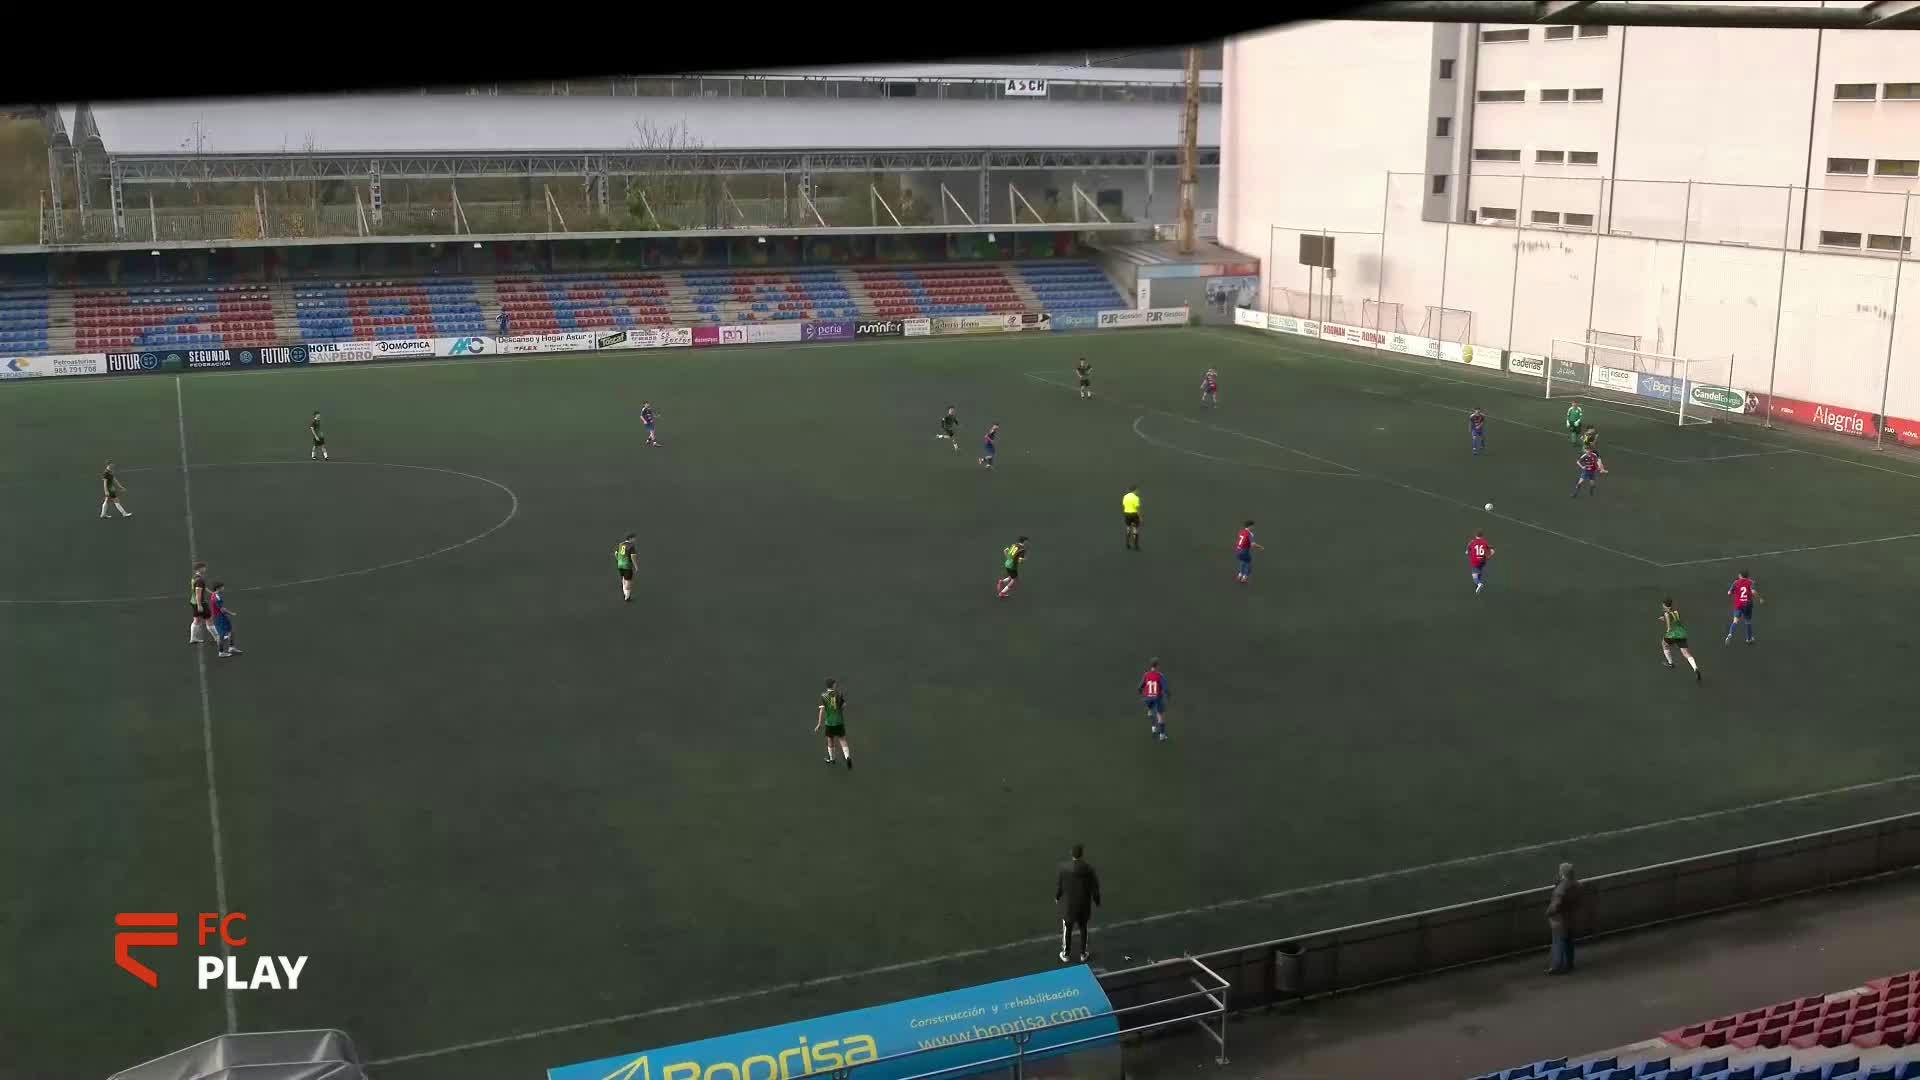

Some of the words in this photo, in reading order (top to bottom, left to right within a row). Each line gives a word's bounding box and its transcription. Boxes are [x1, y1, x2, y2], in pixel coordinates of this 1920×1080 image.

[1007, 80, 1045, 91] ASCH
[309, 343, 340, 352] HOTEL
[189, 350, 231, 362] SEGUNDA
[1813, 405, 1864, 432] Alegría
[1474, 544, 1485, 556] 16
[1740, 586, 1748, 598] 2
[1146, 680, 1158, 694] 11
[910, 1007, 985, 1029] Construcción
[991, 1005, 999, 1015] y
[1004, 988, 1080, 1010] rehabilitación
